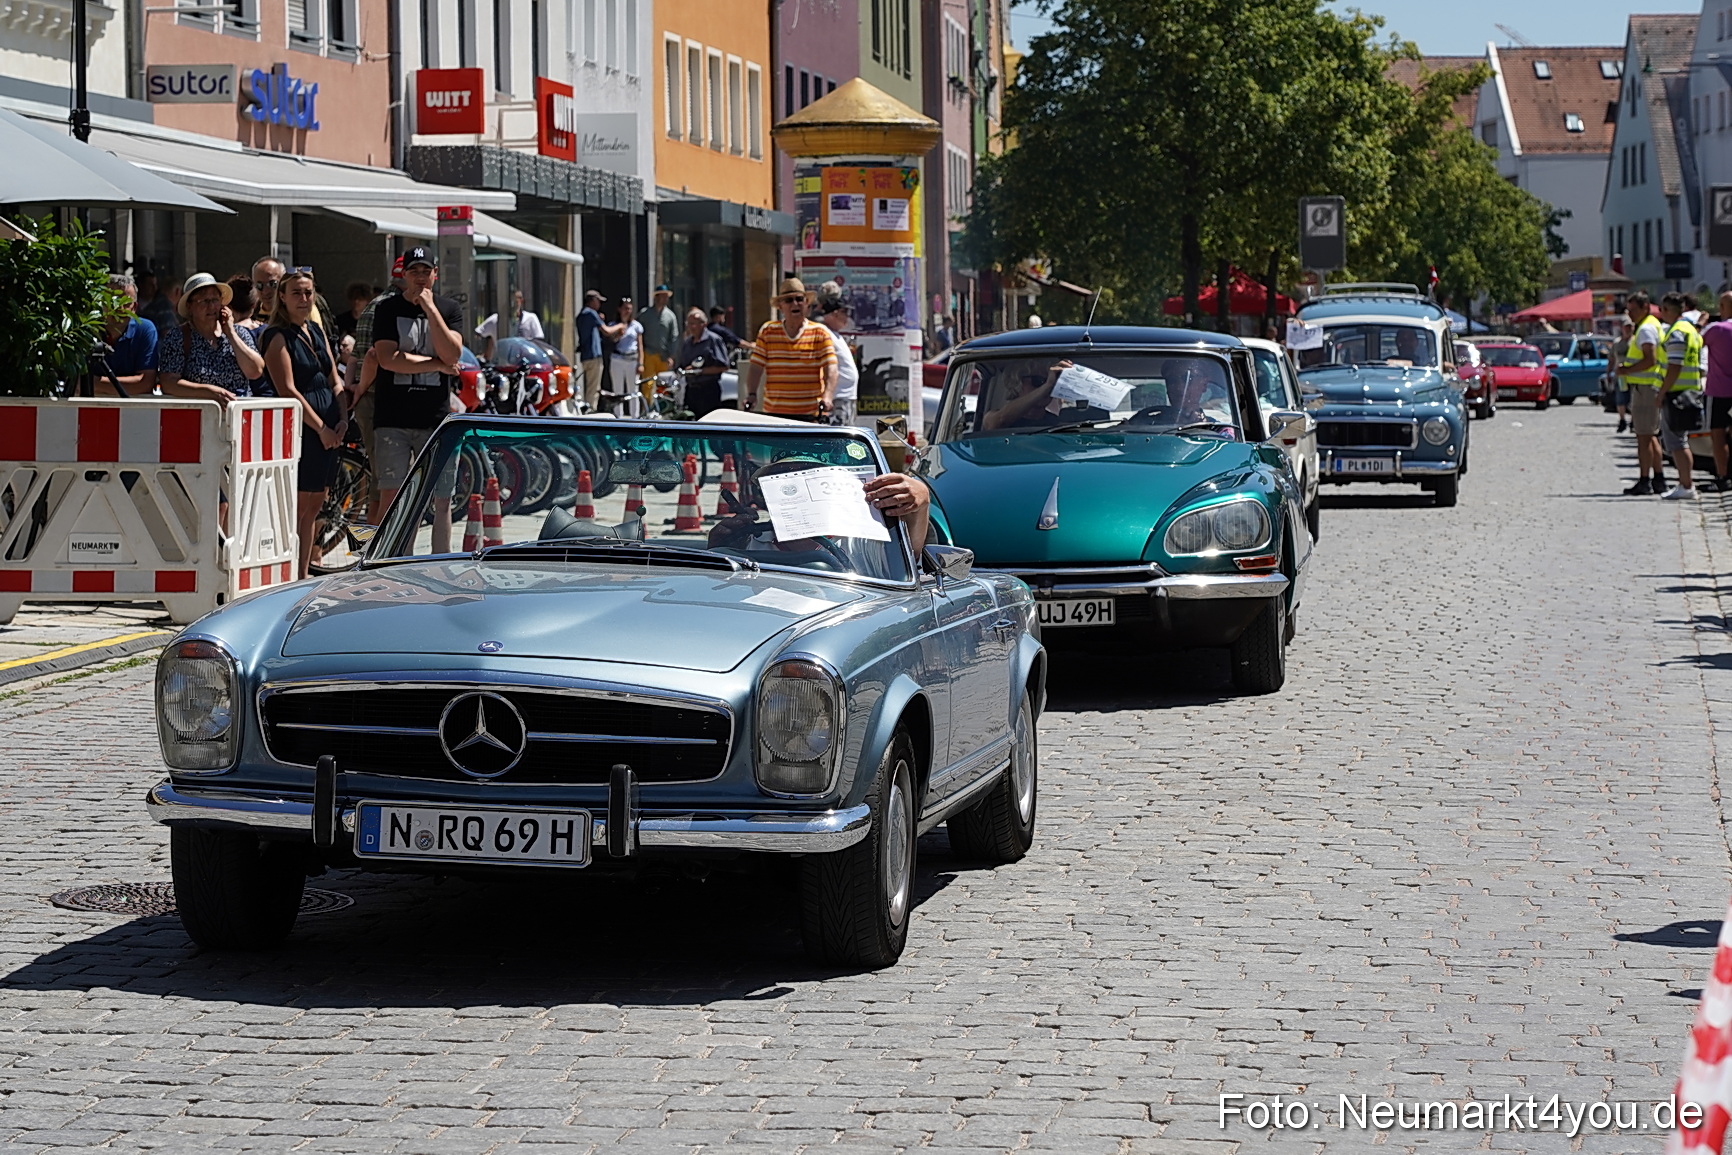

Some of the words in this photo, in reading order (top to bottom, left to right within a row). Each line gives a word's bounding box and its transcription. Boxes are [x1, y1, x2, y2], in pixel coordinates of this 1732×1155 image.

[425, 90, 471, 107] WITT
[1094, 374, 1119, 387] 293
[1348, 460, 1360, 471] PL
[71, 542, 113, 550] NEUMARKT
[1070, 600, 1112, 623] 49H
[365, 834, 375, 845] D
[390, 813, 412, 849] N
[437, 814, 485, 852] RQ
[494, 817, 540, 854] 69
